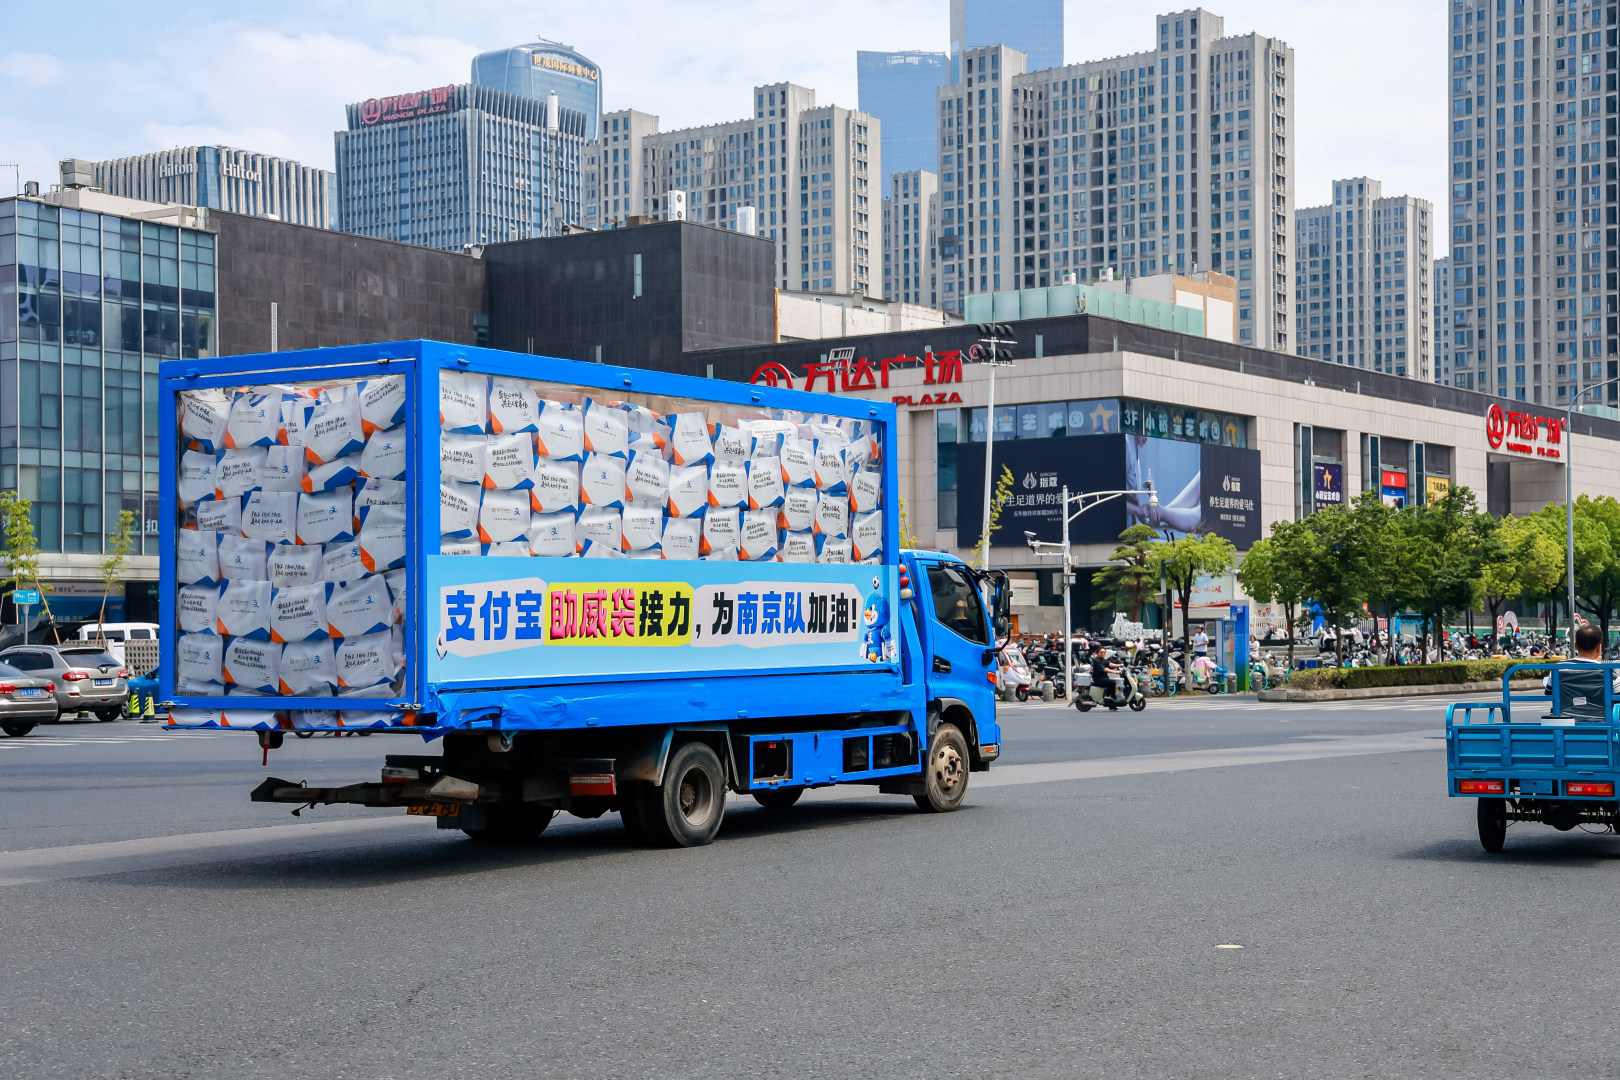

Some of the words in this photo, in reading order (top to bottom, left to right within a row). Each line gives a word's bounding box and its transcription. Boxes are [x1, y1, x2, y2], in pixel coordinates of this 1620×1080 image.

[382, 86, 448, 113] 万达广场
[383, 110, 413, 122] WANDA
[417, 104, 447, 116] PLAZA
[159, 163, 193, 178] Hilton
[223, 162, 261, 182] Hilton
[802, 349, 963, 392] 万达广场
[892, 391, 963, 406] PLAZA
[1124, 409, 1139, 426] 3F
[1505, 411, 1561, 444] 万达广场
